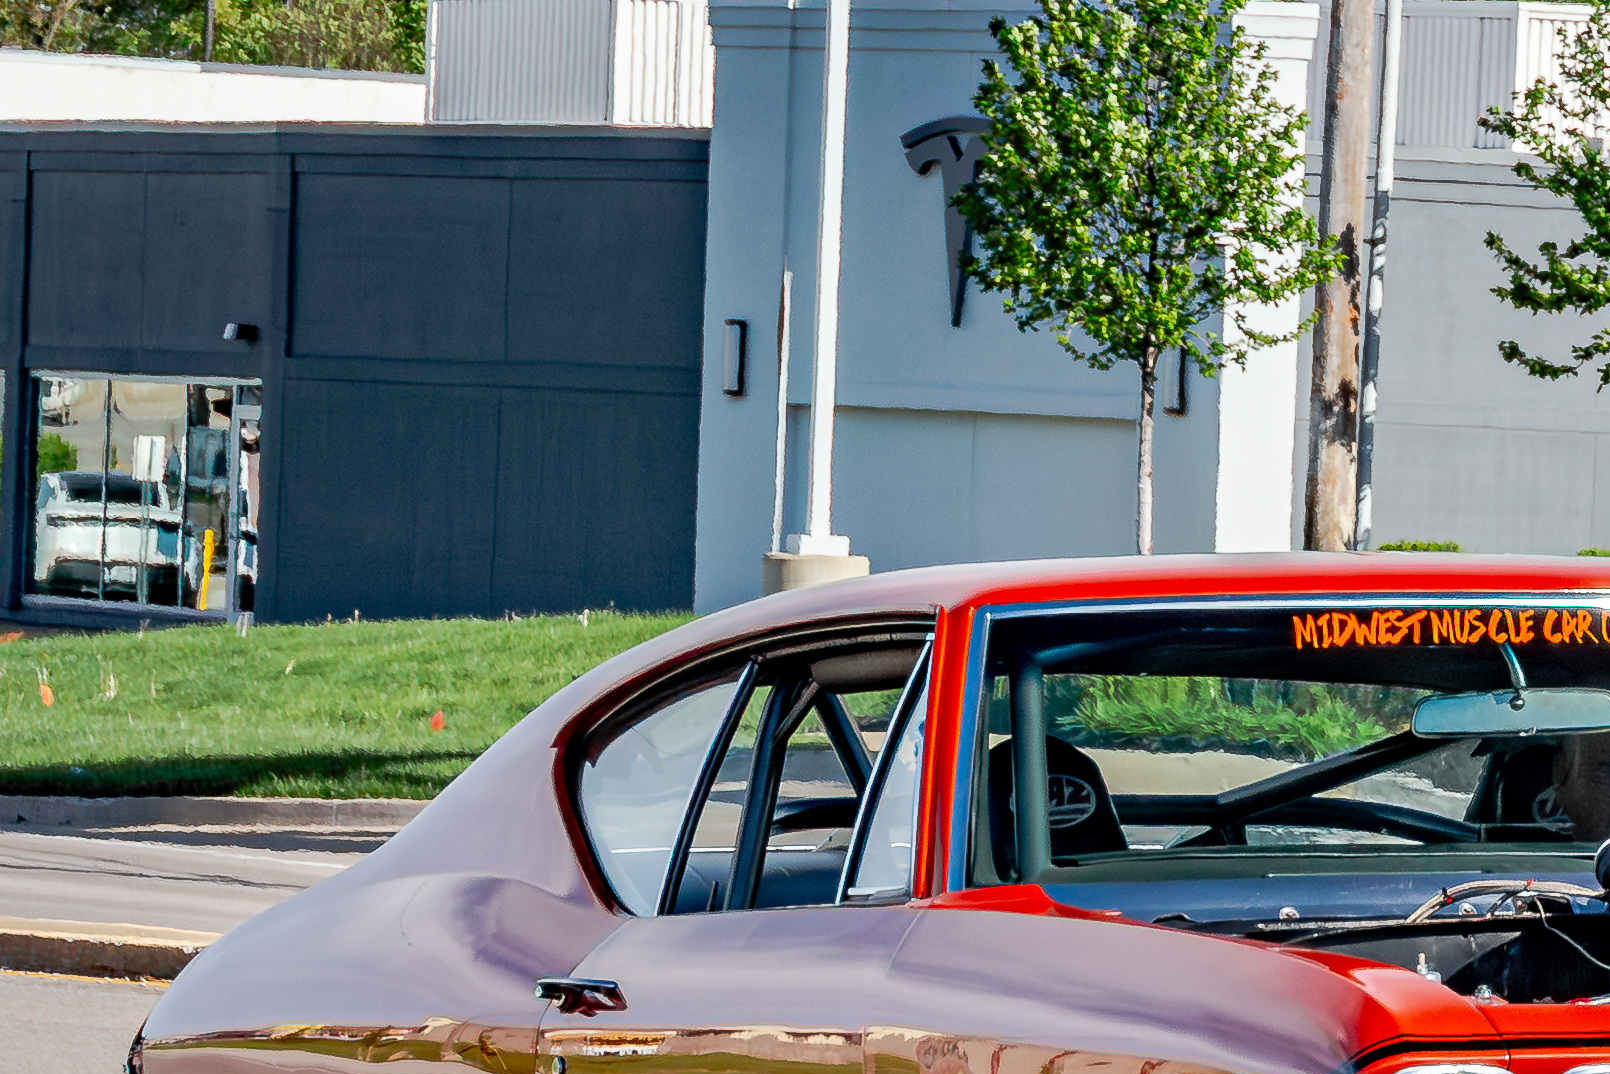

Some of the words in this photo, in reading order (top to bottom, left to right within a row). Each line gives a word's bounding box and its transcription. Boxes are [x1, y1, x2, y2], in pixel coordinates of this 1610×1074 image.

[1293, 609, 1427, 649] MIDWEST
[1430, 609, 1535, 644] MUSCLE
[1543, 609, 1599, 644] CAR
